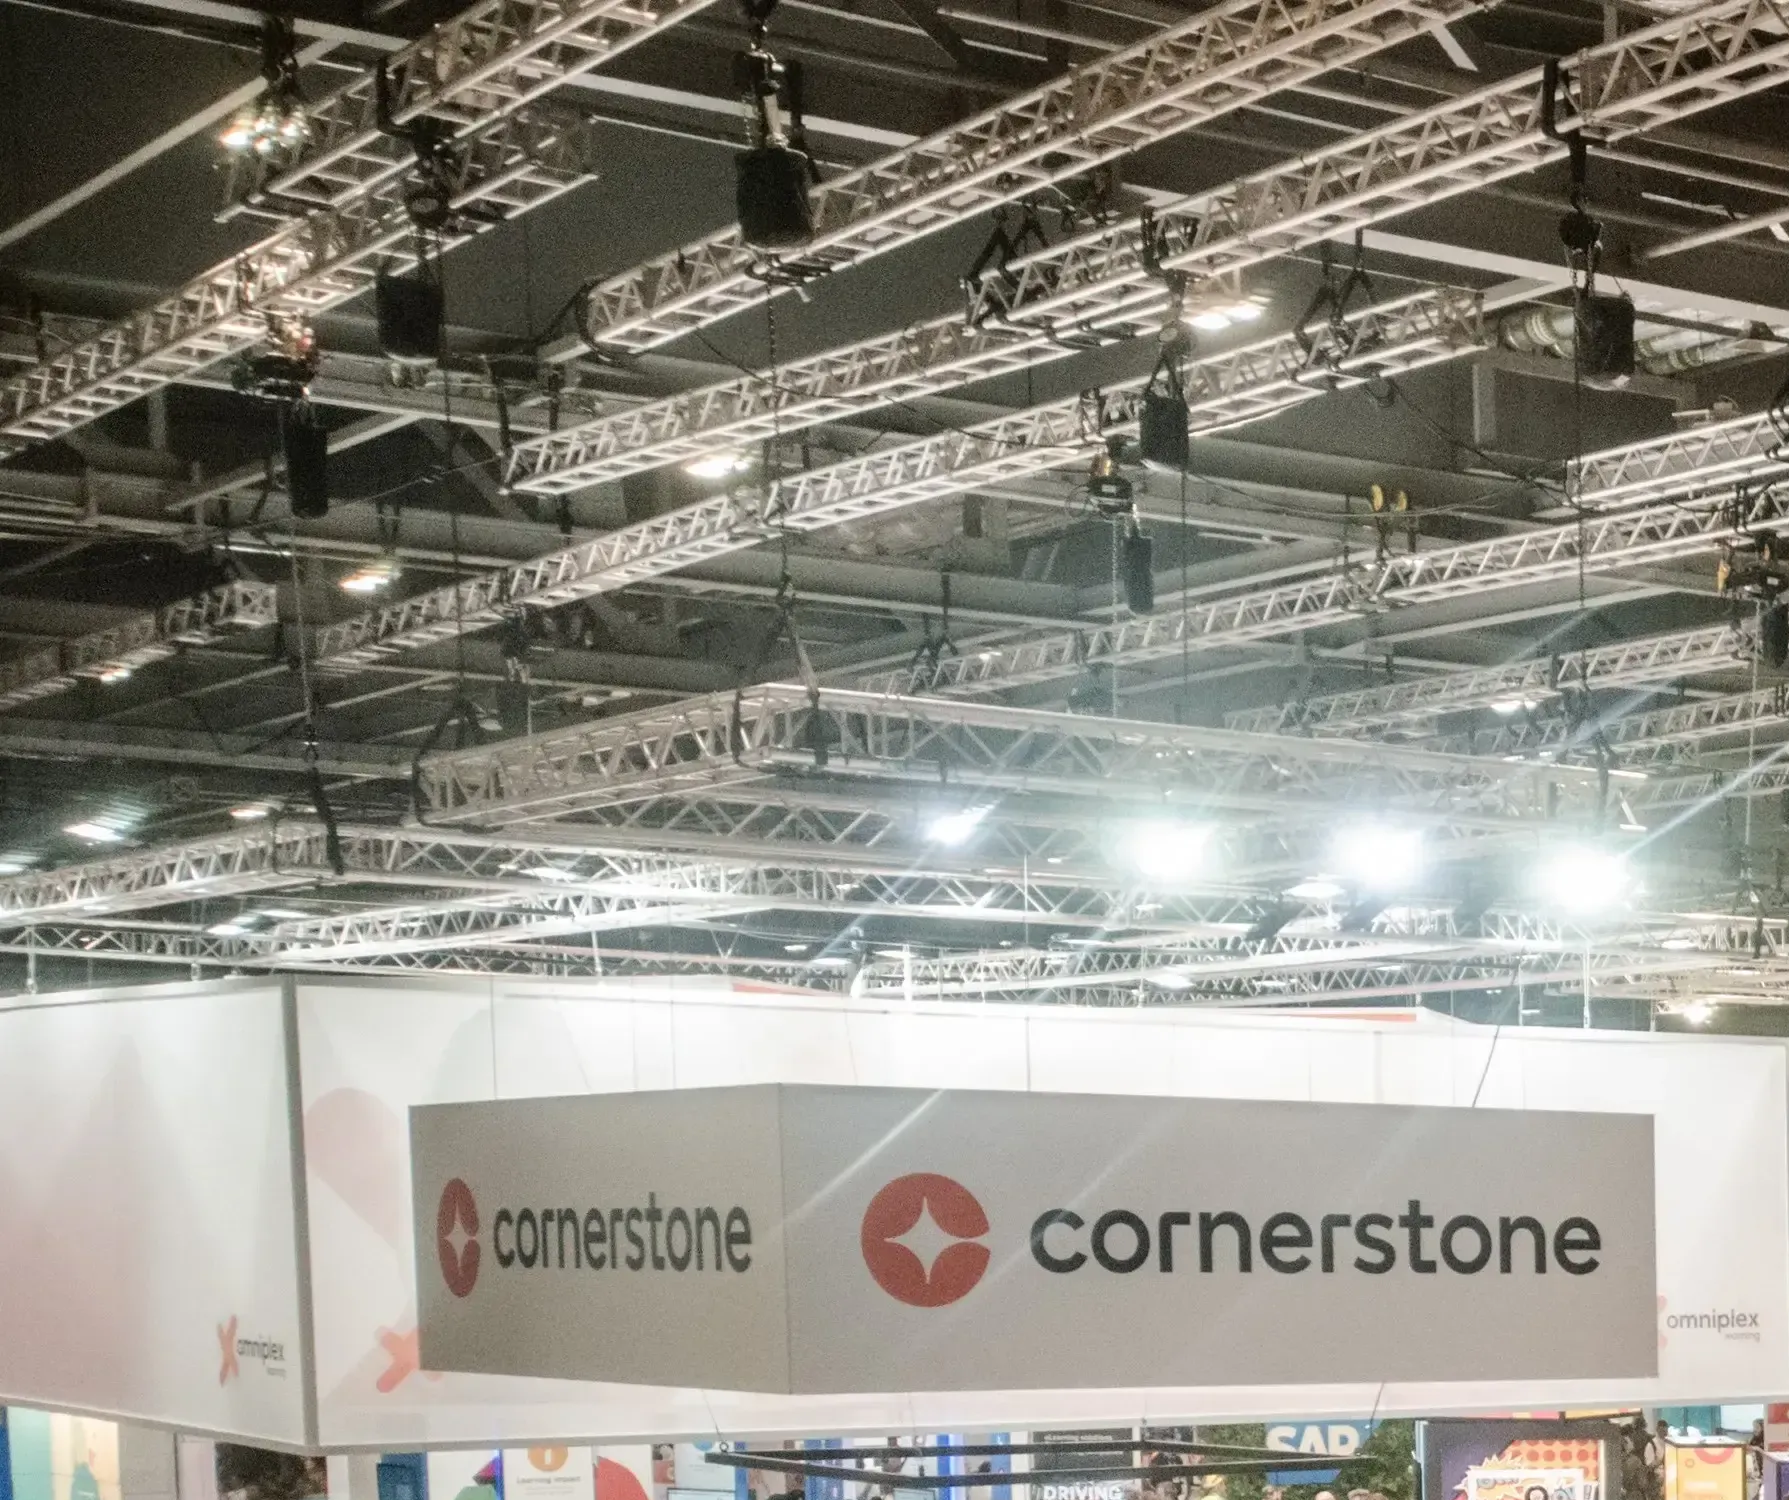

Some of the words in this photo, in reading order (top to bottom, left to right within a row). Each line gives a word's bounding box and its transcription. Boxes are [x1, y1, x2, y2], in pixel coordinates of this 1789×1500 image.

[493, 1192, 753, 1274] cornerstone
[1030, 1199, 1603, 1276] cornerstone
[1666, 1308, 1759, 1334] omniplex
[1043, 1484, 1122, 1500] DRIVING
